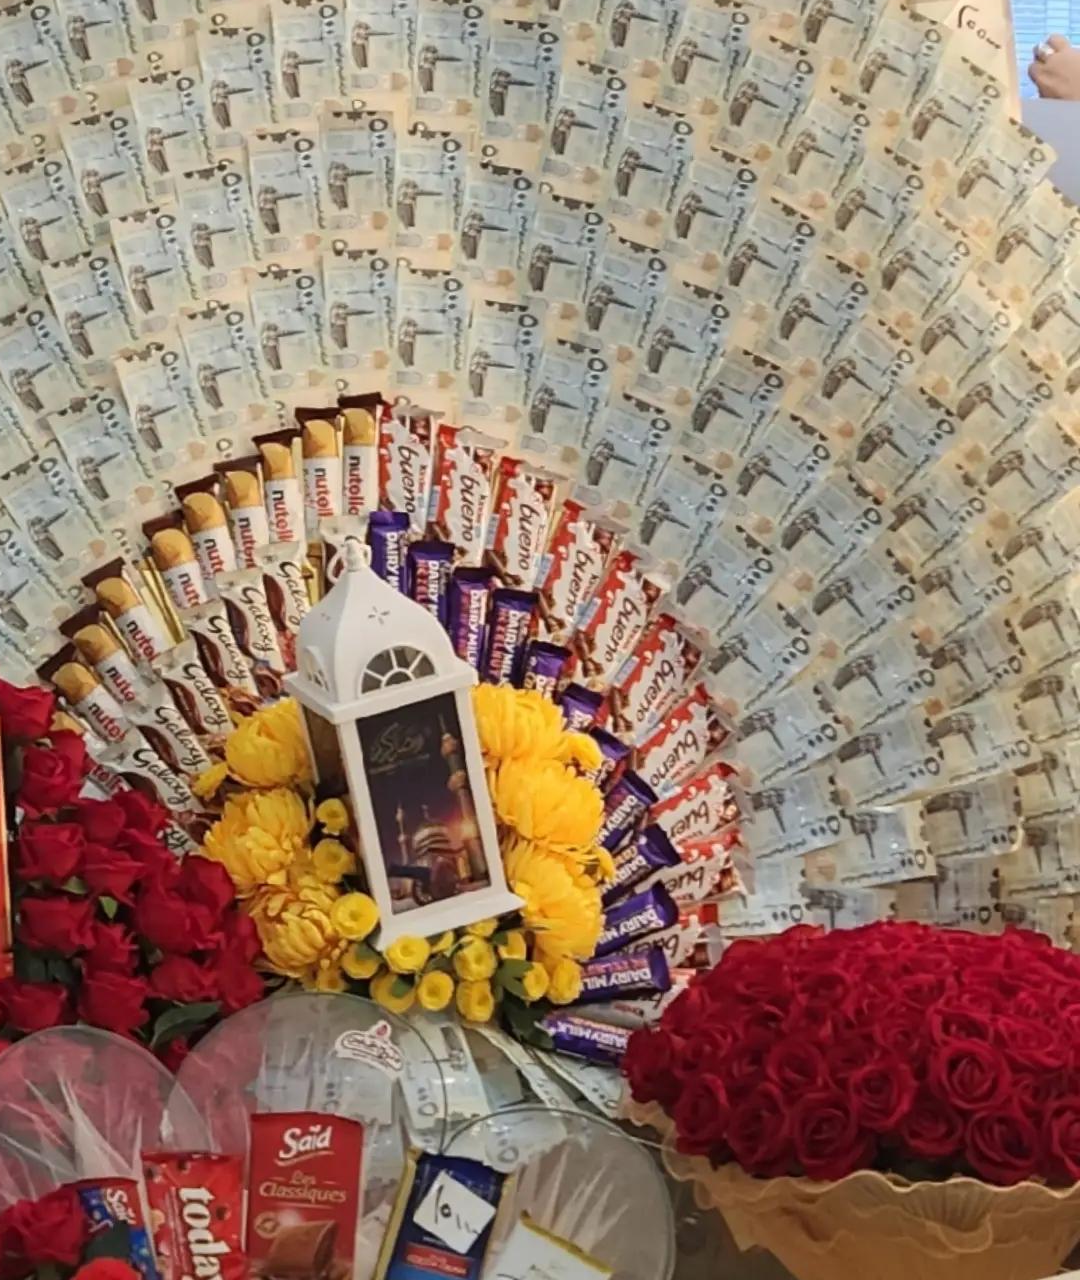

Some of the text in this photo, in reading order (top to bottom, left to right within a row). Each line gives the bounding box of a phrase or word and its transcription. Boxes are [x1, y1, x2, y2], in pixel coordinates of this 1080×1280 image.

[314, 467, 334, 518] nutell
[397, 445, 419, 514] bueno
[460, 475, 480, 542] bueno
[271, 489, 294, 542] nutell
[519, 503, 541, 570] bueno
[566, 550, 594, 617] bueno
[506, 610, 520, 649] DAIRY
[605, 597, 641, 663] bueno
[183, 662, 229, 727] Galaxy
[637, 660, 677, 722] bueno
[155, 706, 207, 770] Galaxy
[650, 729, 699, 787] bueno
[133, 748, 191, 807] Galaxy
[612, 967, 652, 985] DAIRY
[260, 1181, 348, 1204] Classiques
